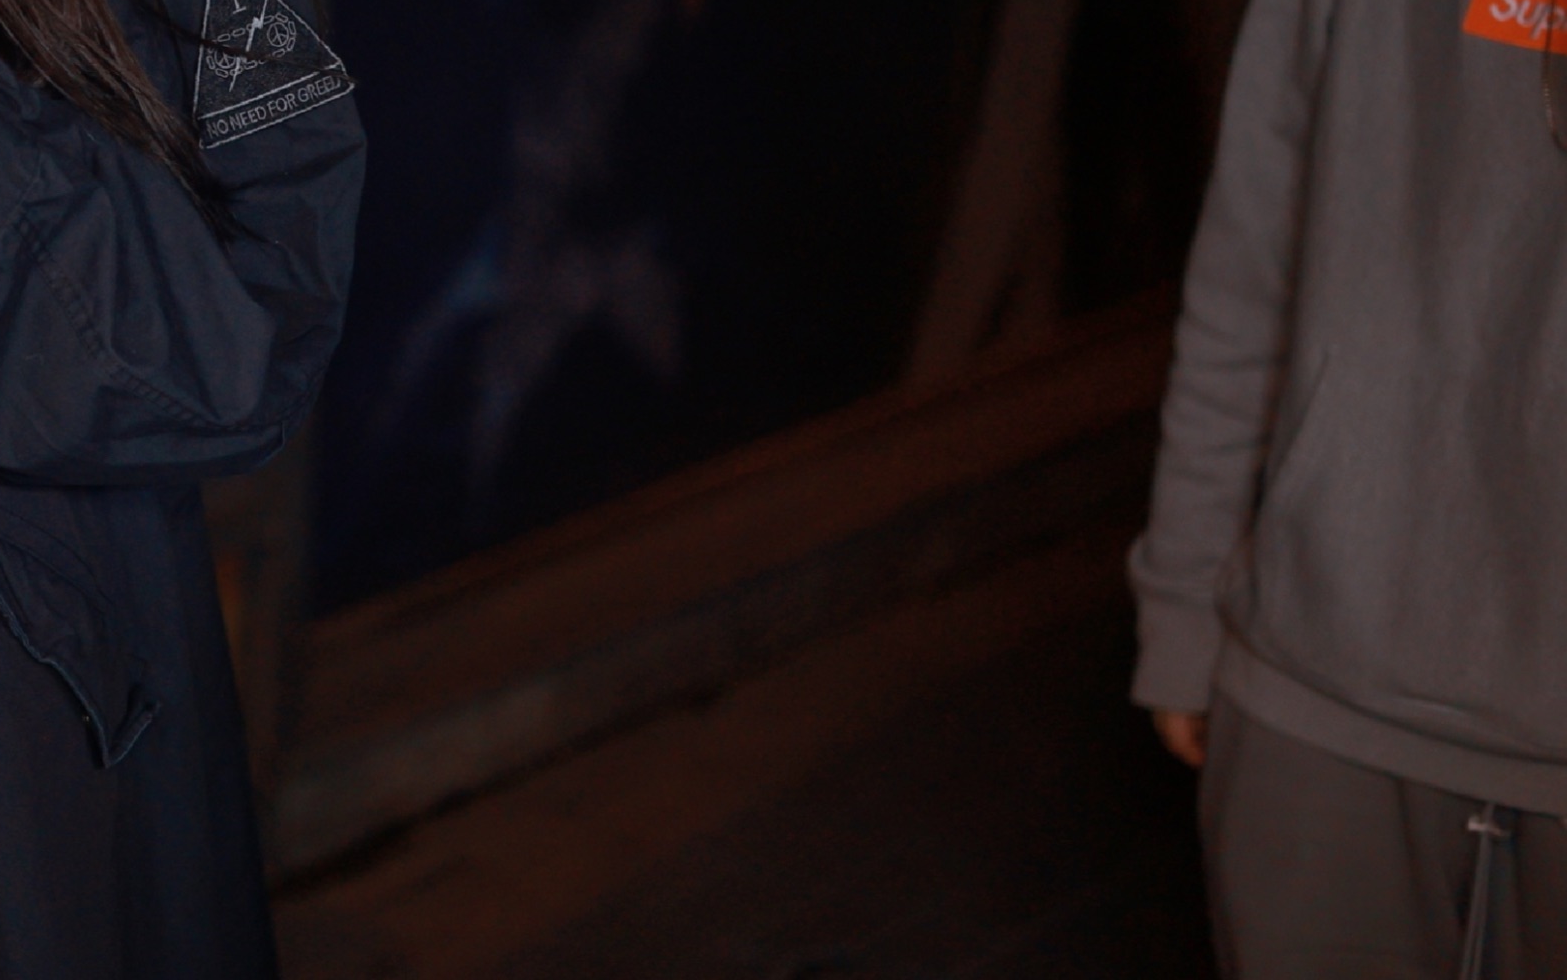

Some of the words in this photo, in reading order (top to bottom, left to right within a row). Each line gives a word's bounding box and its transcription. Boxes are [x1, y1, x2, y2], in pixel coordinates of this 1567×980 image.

[206, 119, 229, 139] NO
[229, 106, 266, 131] NEED
[267, 93, 298, 117] FOR
